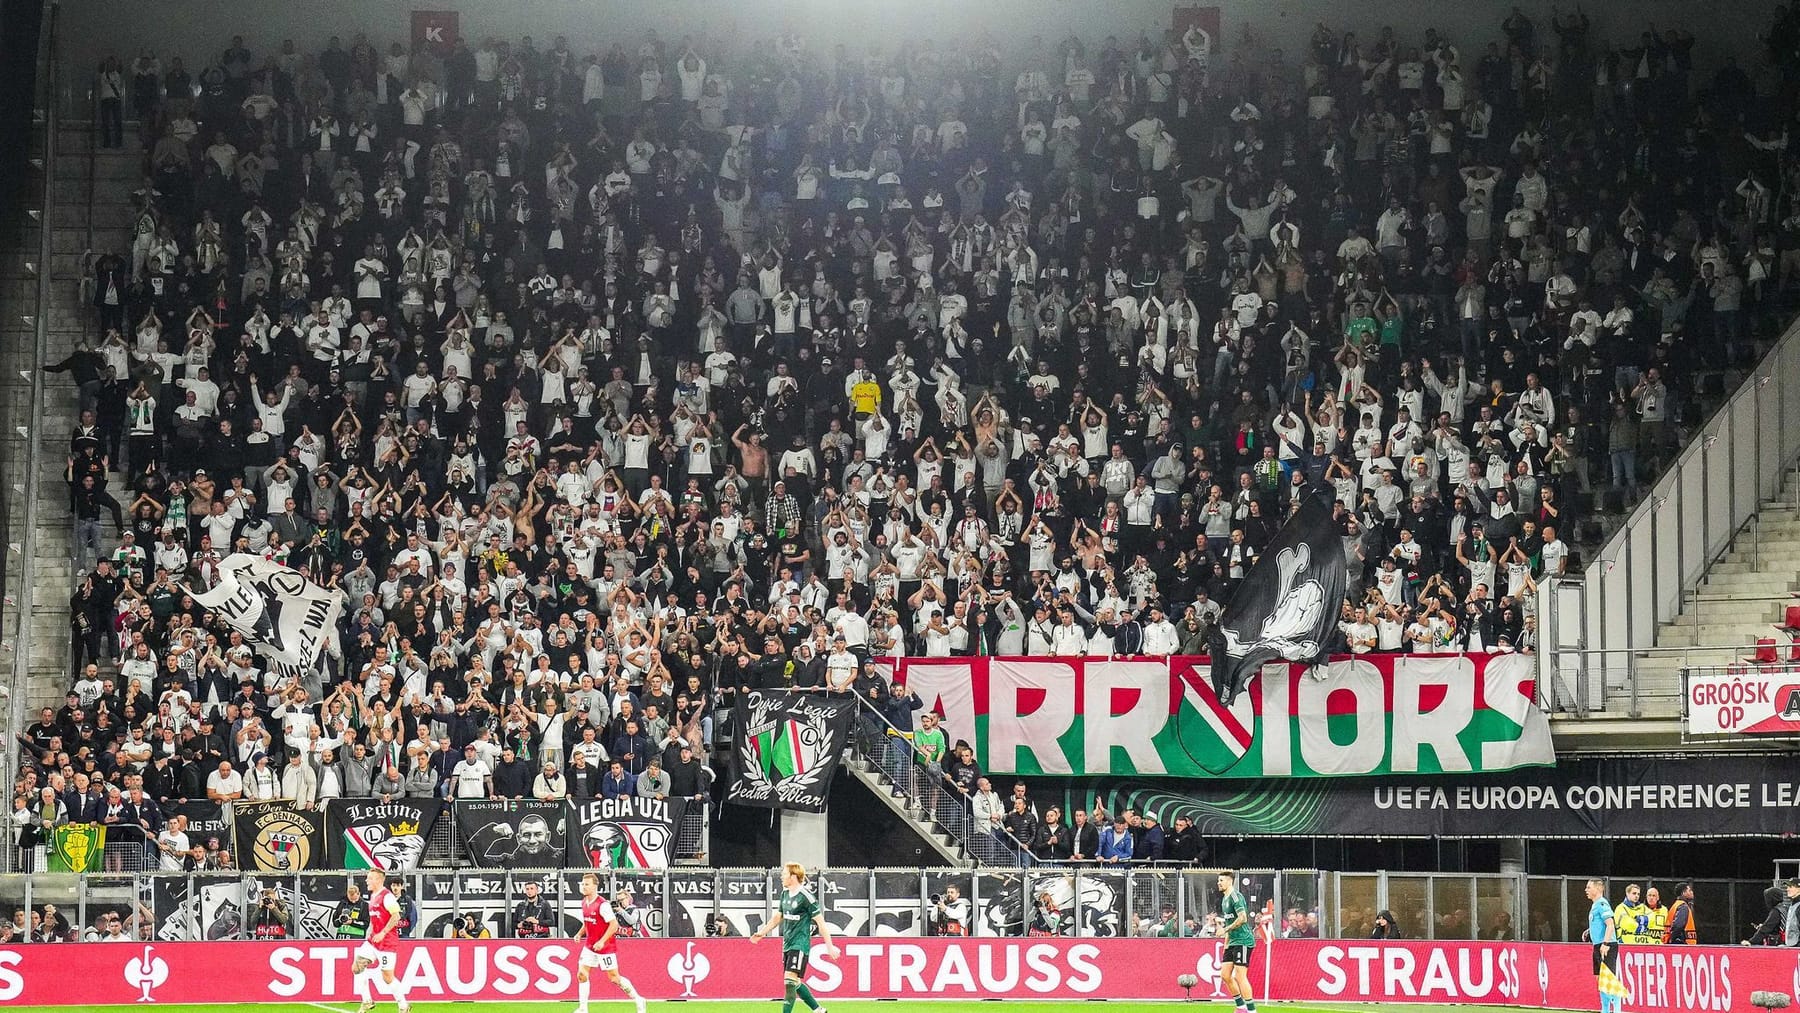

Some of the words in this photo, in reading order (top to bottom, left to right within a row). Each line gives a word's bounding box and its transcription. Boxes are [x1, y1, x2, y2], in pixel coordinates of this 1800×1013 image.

[426, 27, 443, 42] K
[748, 691, 783, 712] Dwie
[786, 695, 838, 721] Legie
[1692, 677, 1770, 706] GROÔSK
[1783, 690, 1800, 717] A
[874, 656, 1557, 775] ARRIORS
[1717, 706, 1744, 729] OP
[580, 797, 634, 826] LEGIA
[1374, 786, 1450, 810] UEFA
[1456, 786, 1561, 810] EUROPA
[1566, 783, 1751, 811] CONFERENCE
[346, 803, 423, 823] Legijna
[267, 946, 572, 997] STRAUSS
[602, 956, 613, 968] 10
[806, 943, 1103, 993] STRAUSS
[1316, 945, 1520, 999] STRAUSS
[1671, 953, 1733, 1012] TOOLS
